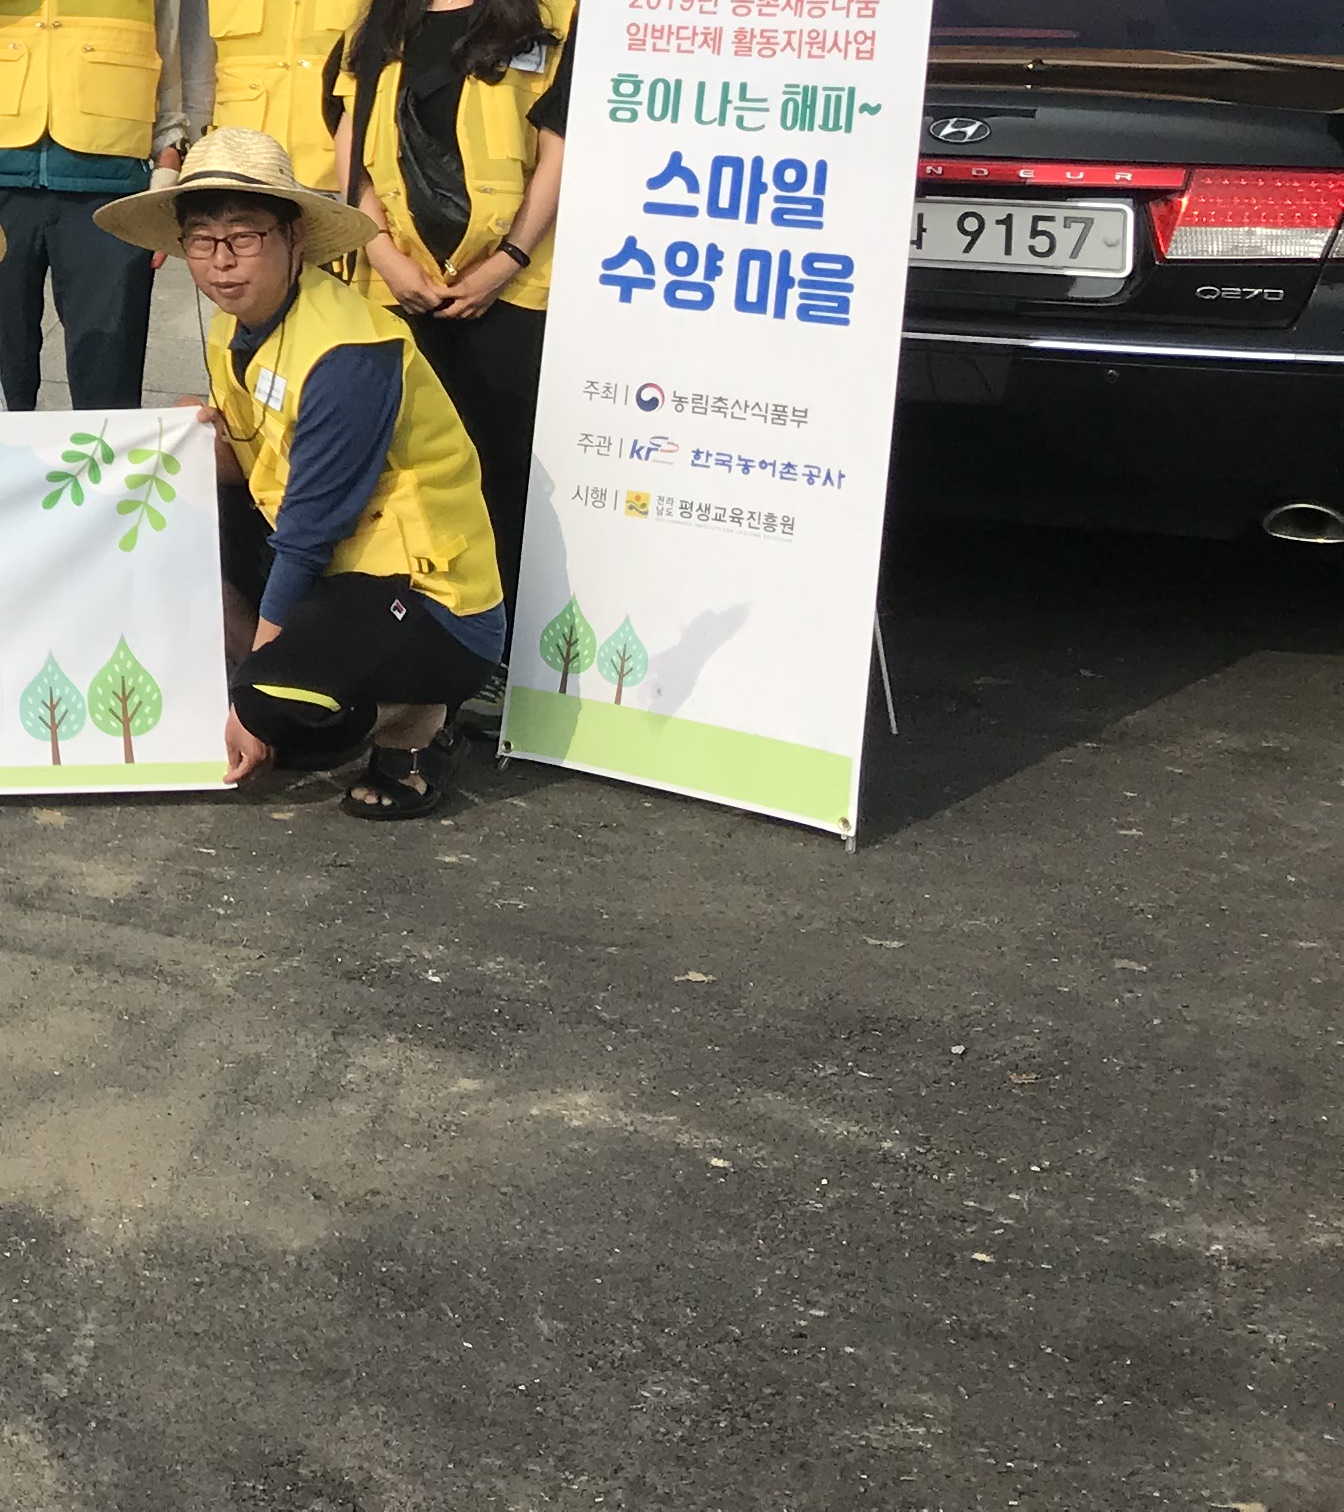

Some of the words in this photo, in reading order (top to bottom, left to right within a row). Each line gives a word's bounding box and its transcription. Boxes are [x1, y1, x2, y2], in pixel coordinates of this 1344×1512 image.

[626, 22, 723, 56] 일반단체
[731, 26, 876, 60] 활동지원사업
[608, 73, 682, 123] 흥이
[695, 81, 769, 131] 나는
[780, 84, 881, 133] 해피~
[643, 151, 827, 229] 스마일
[926, 166, 1133, 181] NDEUR
[956, 211, 1095, 259] 9157
[599, 236, 724, 311] 수양
[735, 248, 854, 326] 마을
[1196, 286, 1284, 301] Q270
[583, 380, 617, 404] 주최
[671, 391, 808, 428] 농림축산식품부
[577, 433, 612, 456] 주관
[691, 448, 845, 489] 한국농어촌공사
[571, 485, 607, 508] 시행
[679, 500, 795, 535] 평생교육진흥원
